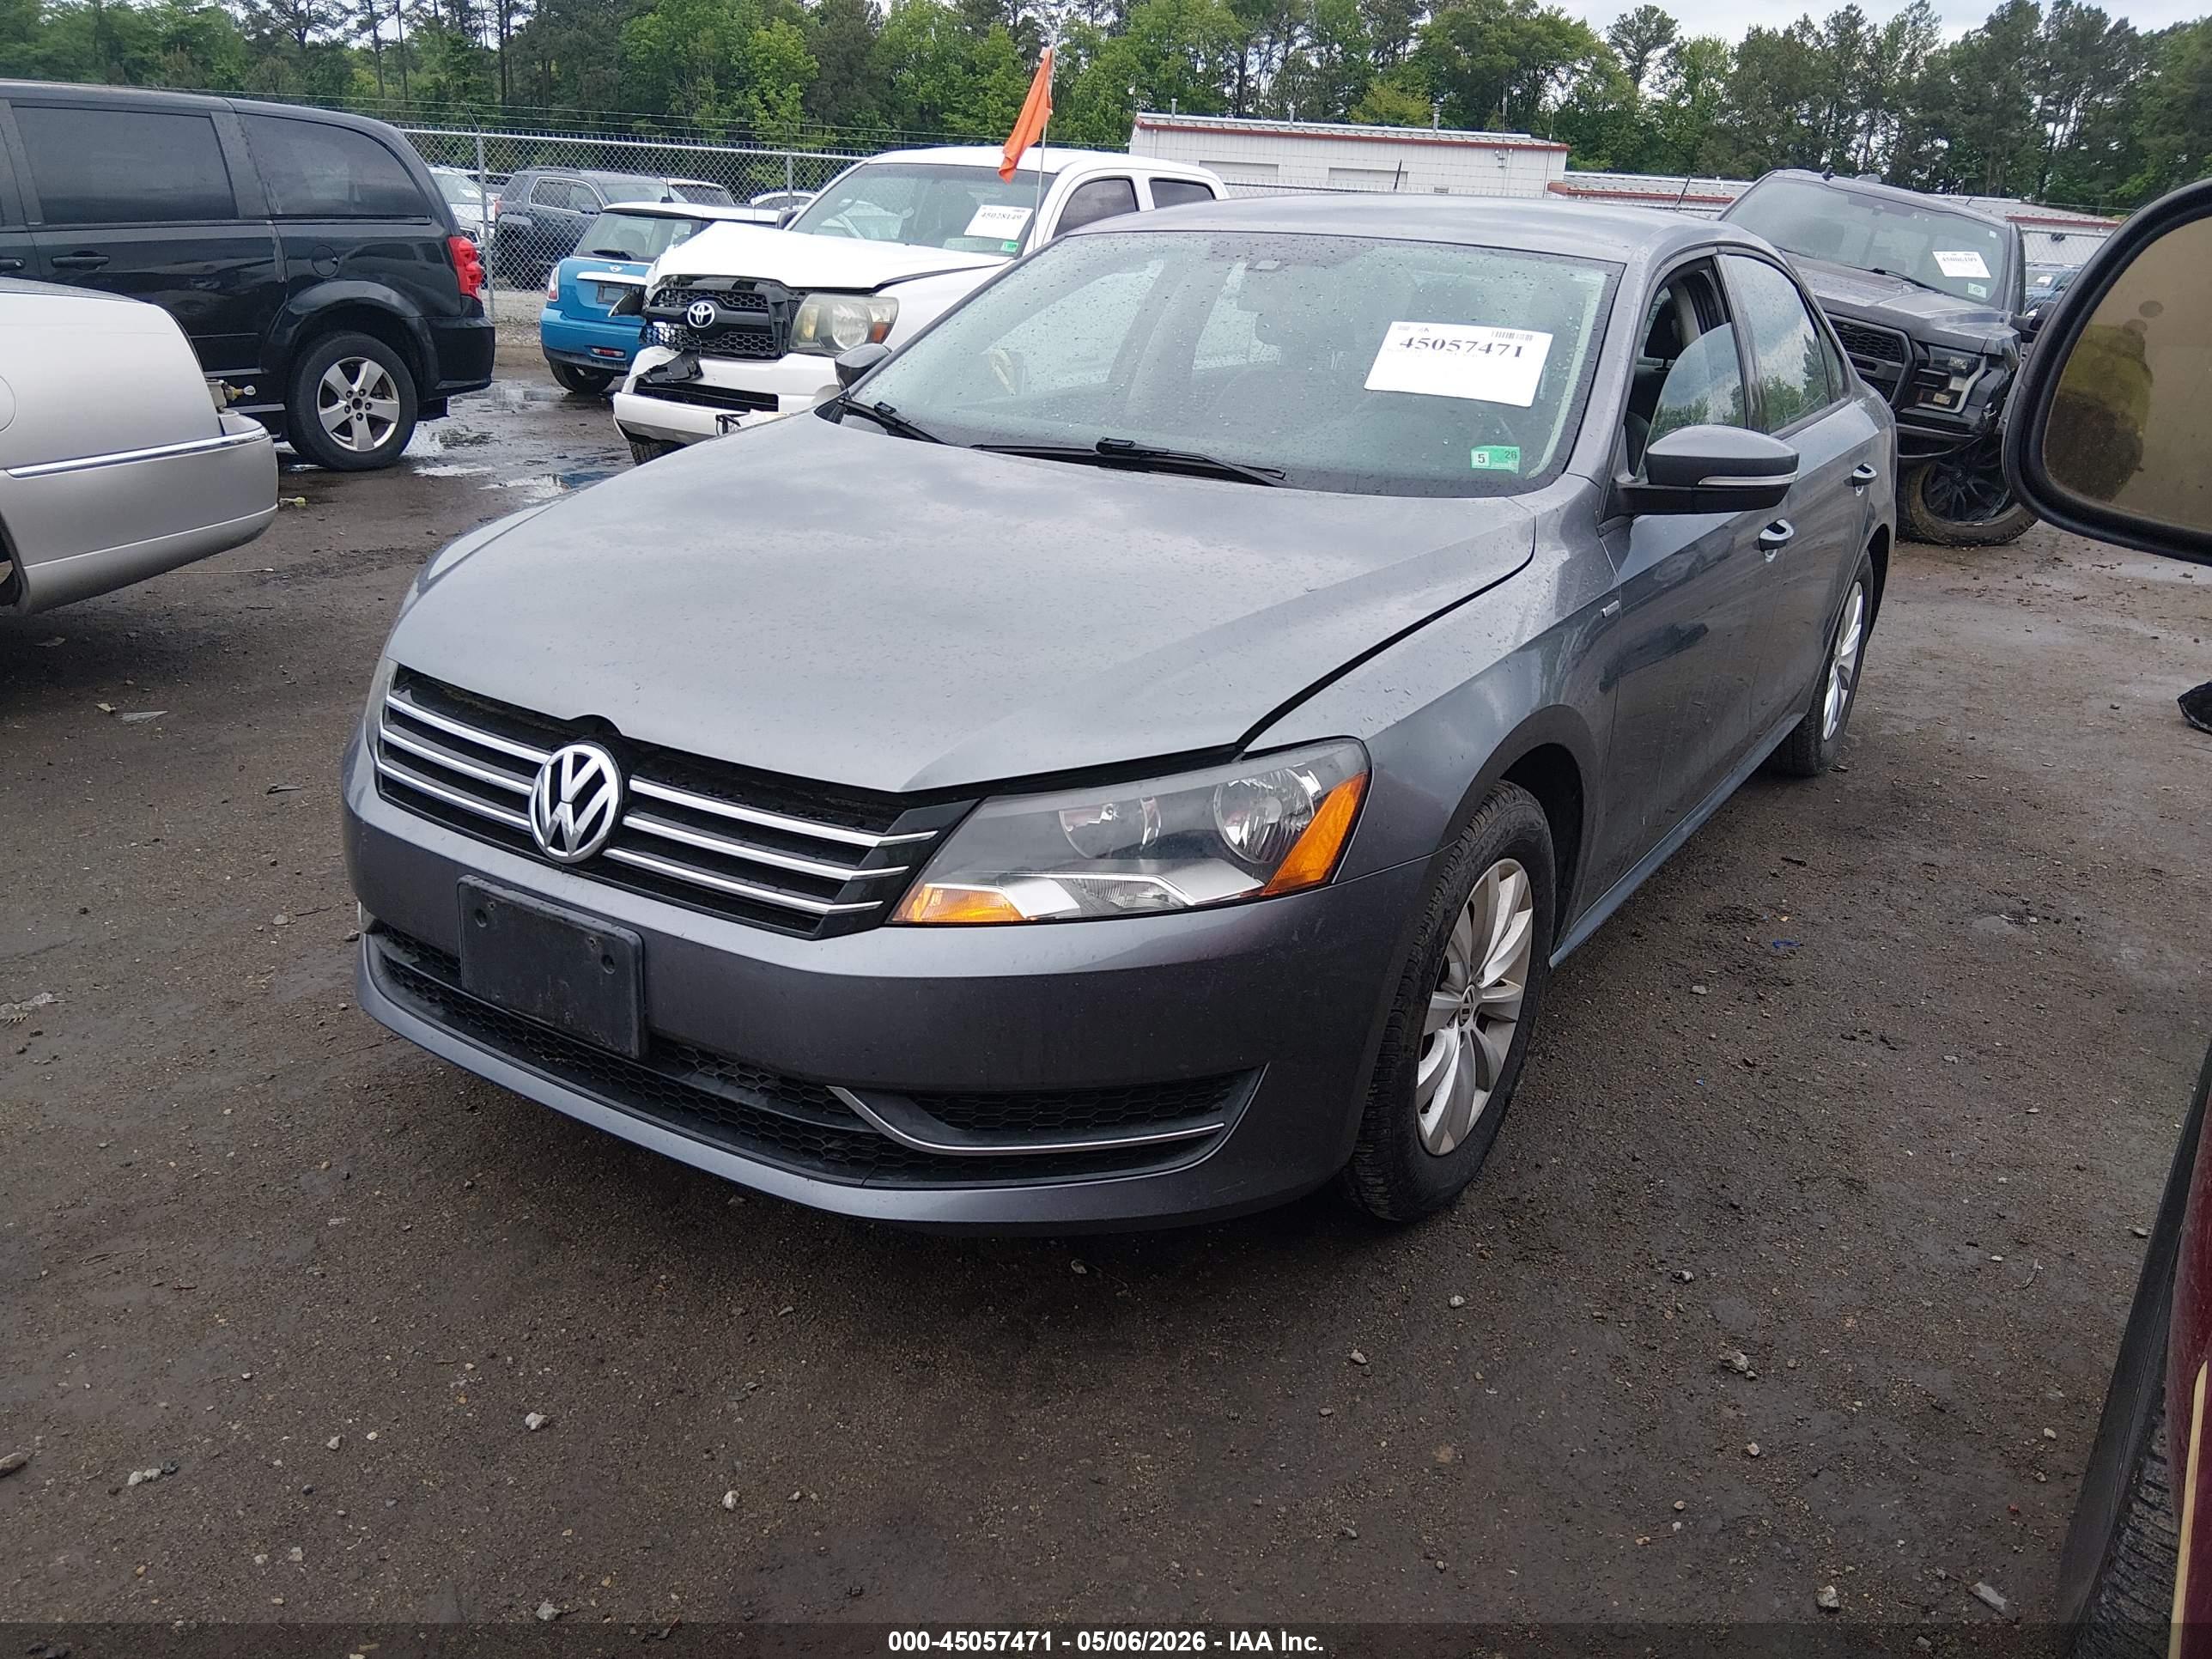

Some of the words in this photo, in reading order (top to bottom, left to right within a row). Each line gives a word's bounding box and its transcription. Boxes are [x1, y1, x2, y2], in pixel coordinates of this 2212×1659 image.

[1399, 337, 1524, 358] 45057471
[1478, 453, 1486, 464] 5
[1504, 450, 1517, 459] 26
